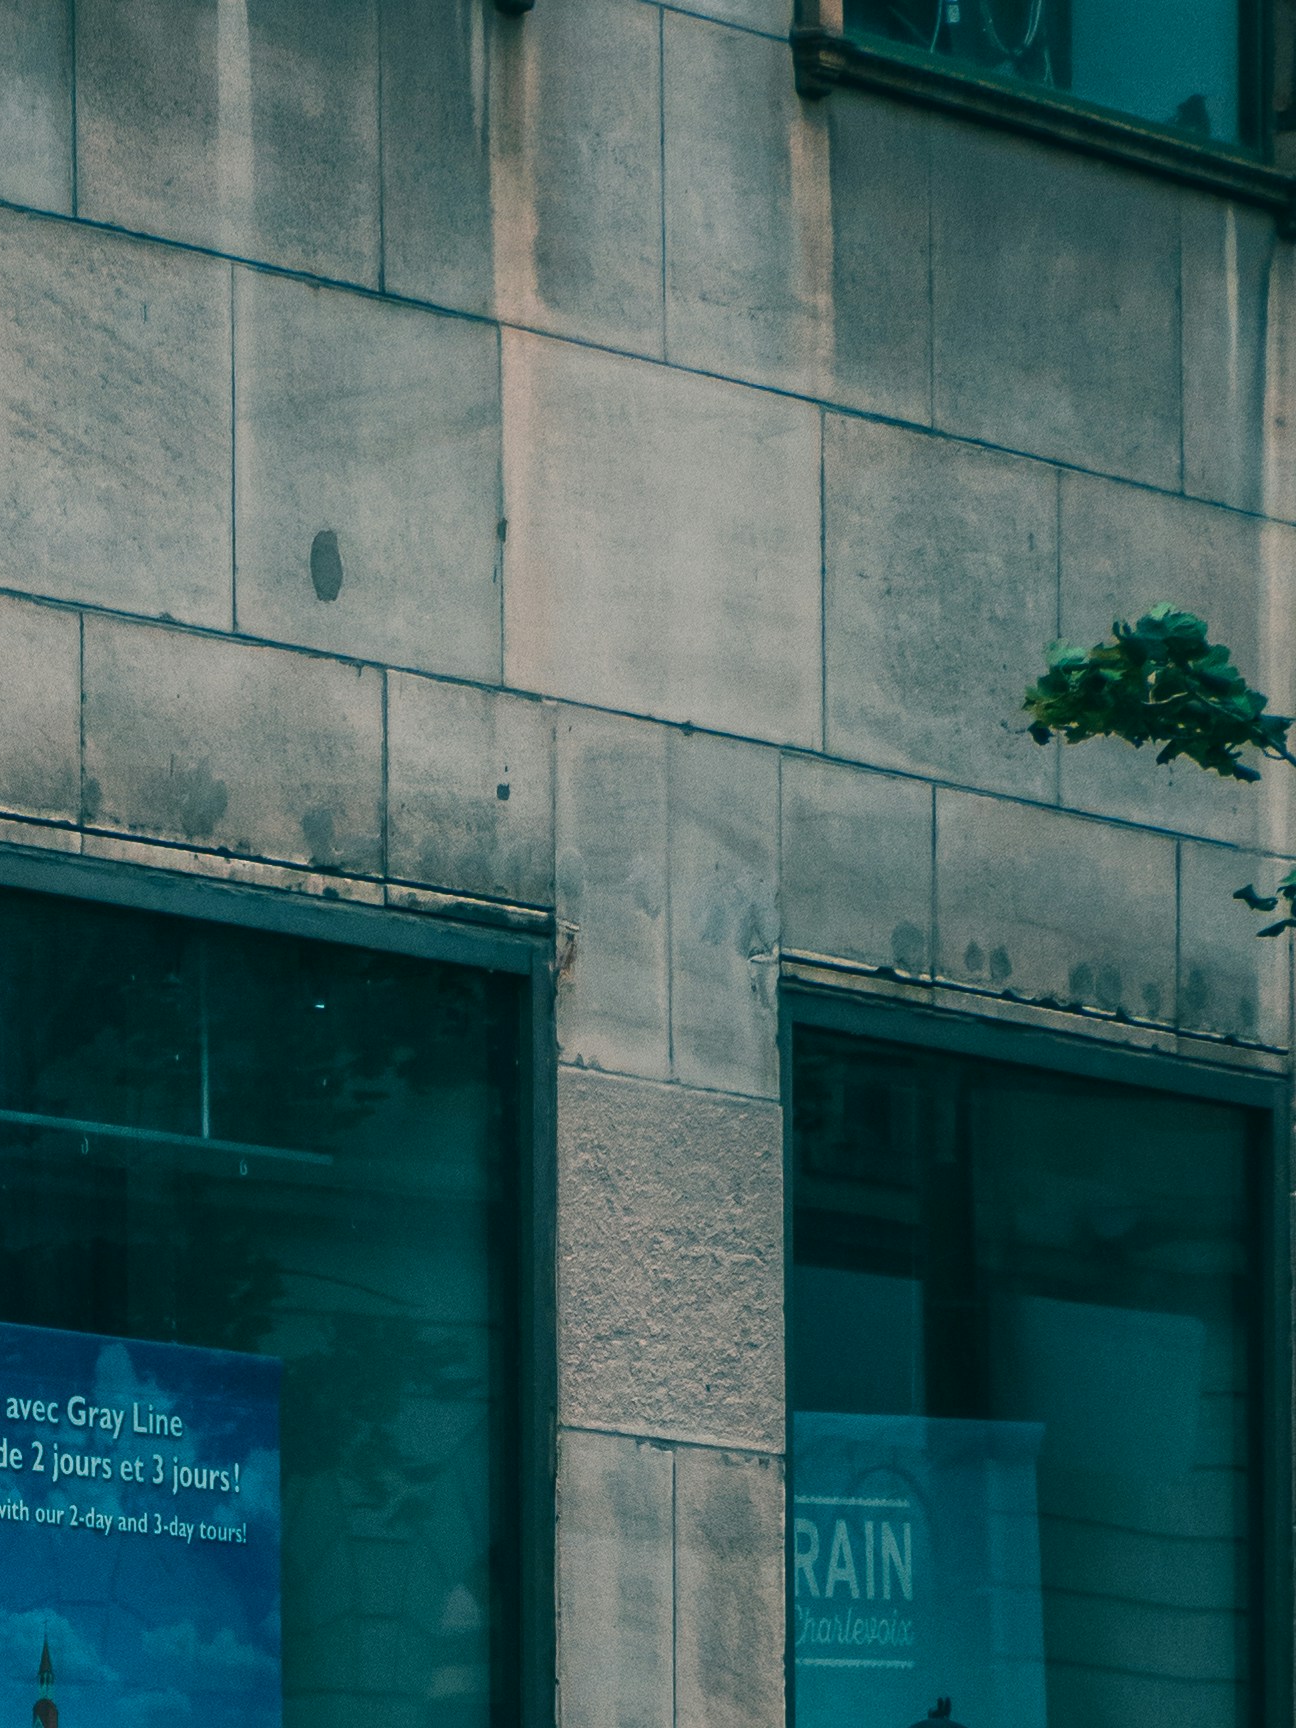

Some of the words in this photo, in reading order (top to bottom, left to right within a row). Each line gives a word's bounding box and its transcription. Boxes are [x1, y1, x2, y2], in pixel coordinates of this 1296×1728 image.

[6, 1396, 59, 1424] avec
[67, 1395, 125, 1440] Gray
[133, 1402, 183, 1437] Line
[31, 1440, 45, 1472] 2
[52, 1442, 112, 1483] jours
[119, 1456, 145, 1483] et
[152, 1454, 165, 1485] 3
[35, 1507, 65, 1526] our
[69, 1504, 113, 1536] 2-day
[118, 1512, 149, 1534] and
[153, 1513, 195, 1544] 3-day
[199, 1521, 248, 1544] tours!
[794, 1518, 914, 1601] RAIN
